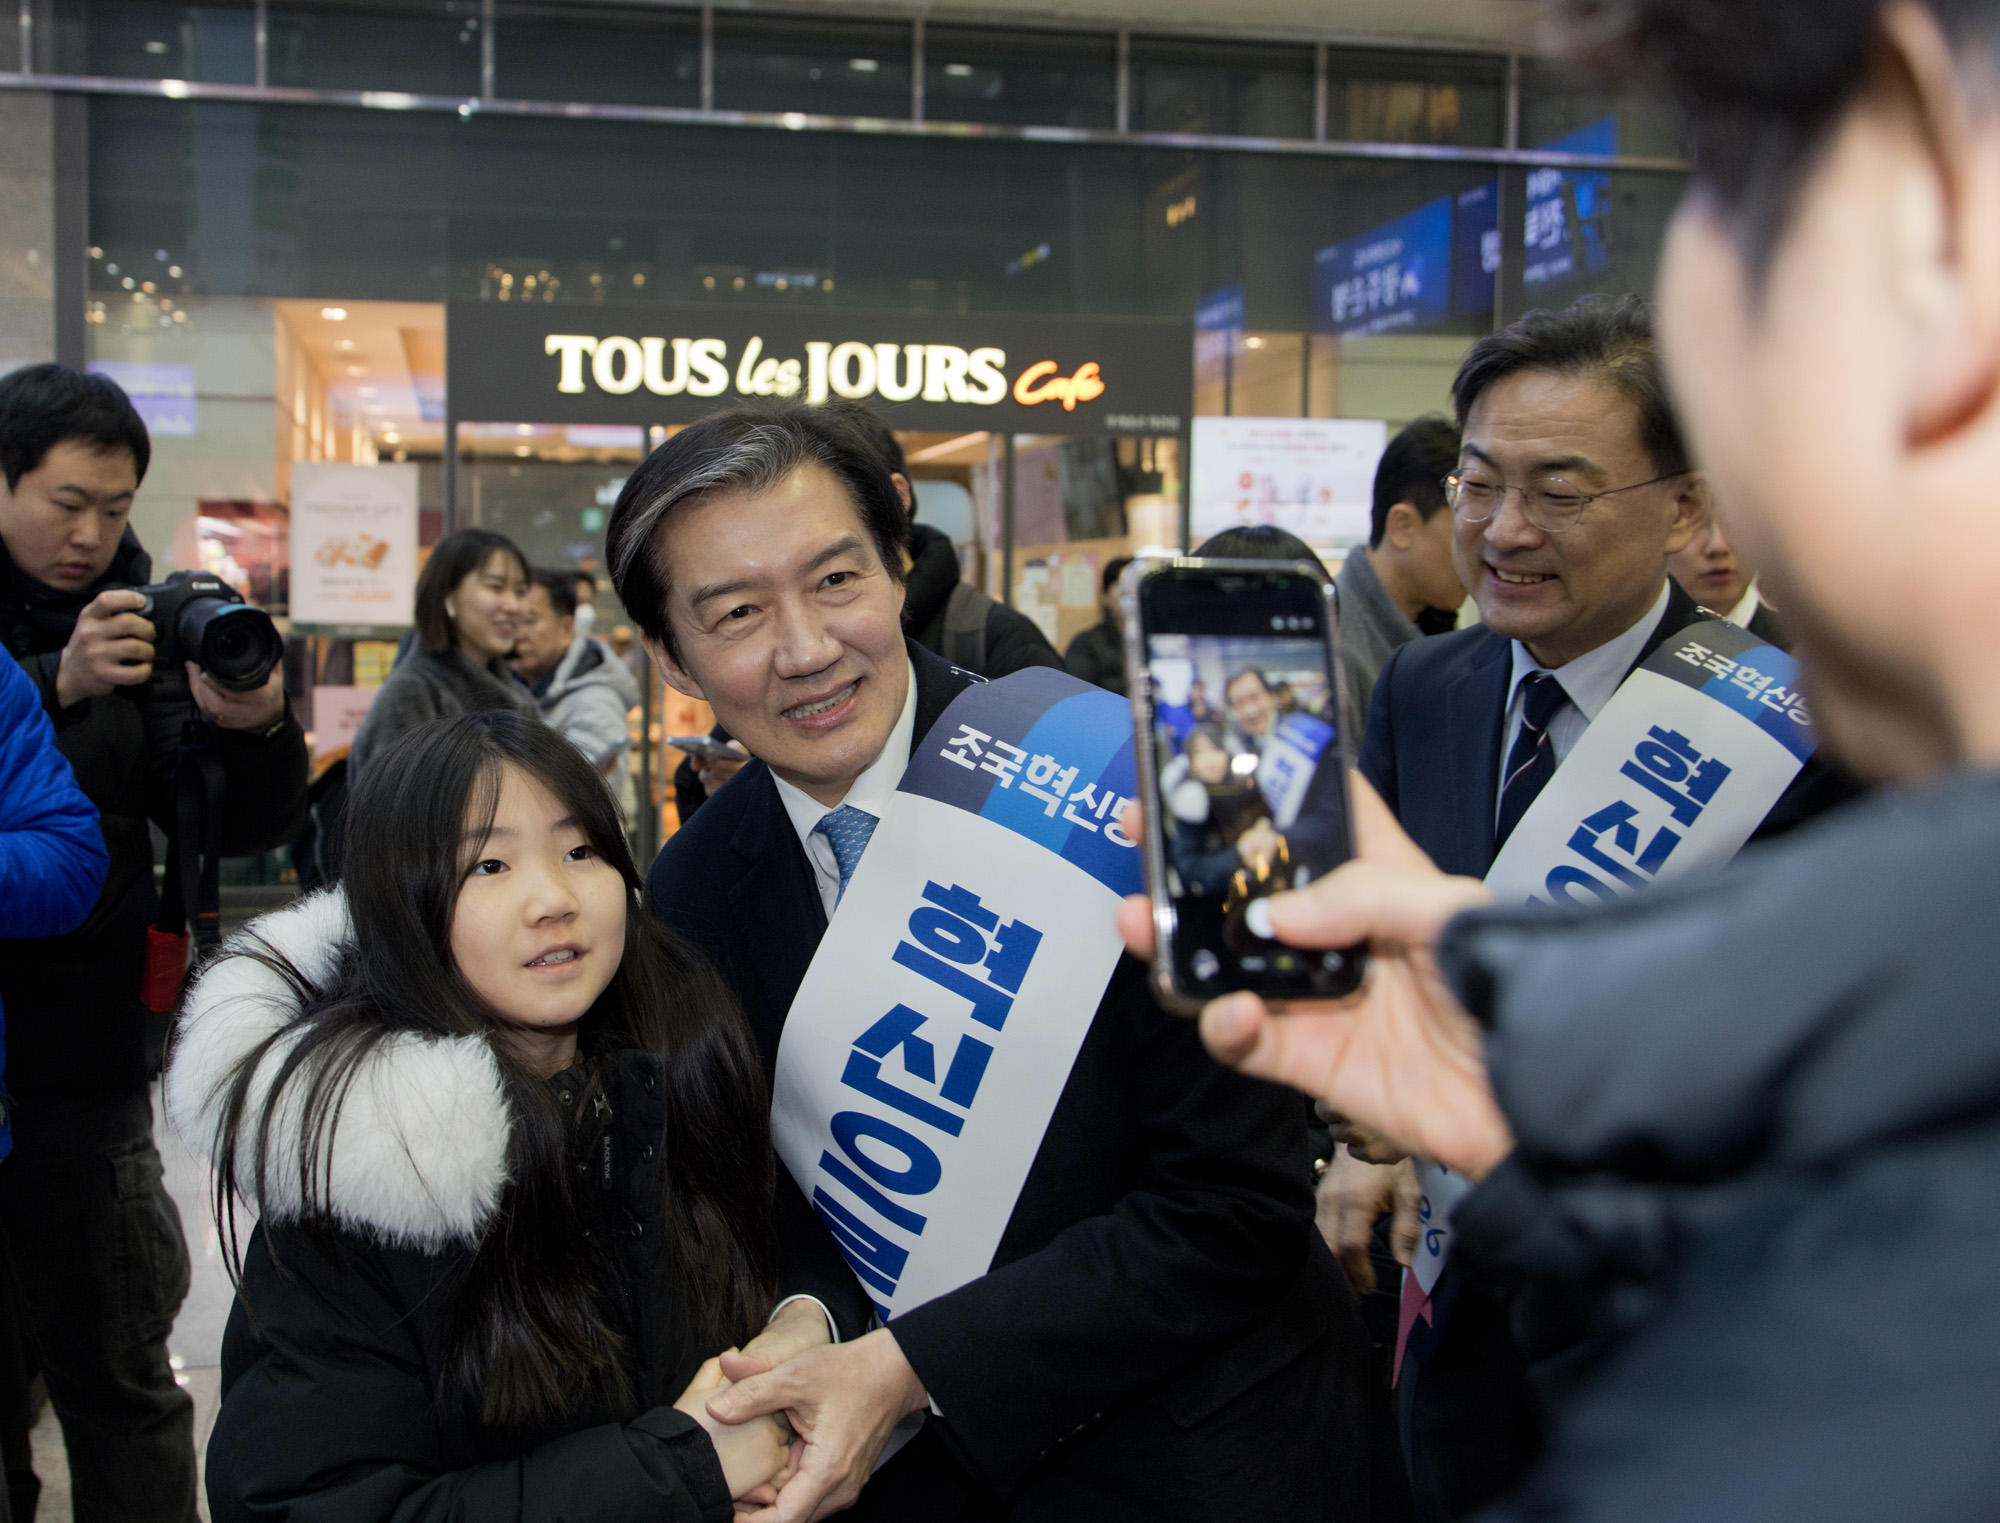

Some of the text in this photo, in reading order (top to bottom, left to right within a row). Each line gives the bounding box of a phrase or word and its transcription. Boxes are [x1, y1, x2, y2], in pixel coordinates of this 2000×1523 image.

[544, 334, 730, 397] TOUS
[735, 336, 801, 397] les
[804, 341, 1008, 406] JOURS
